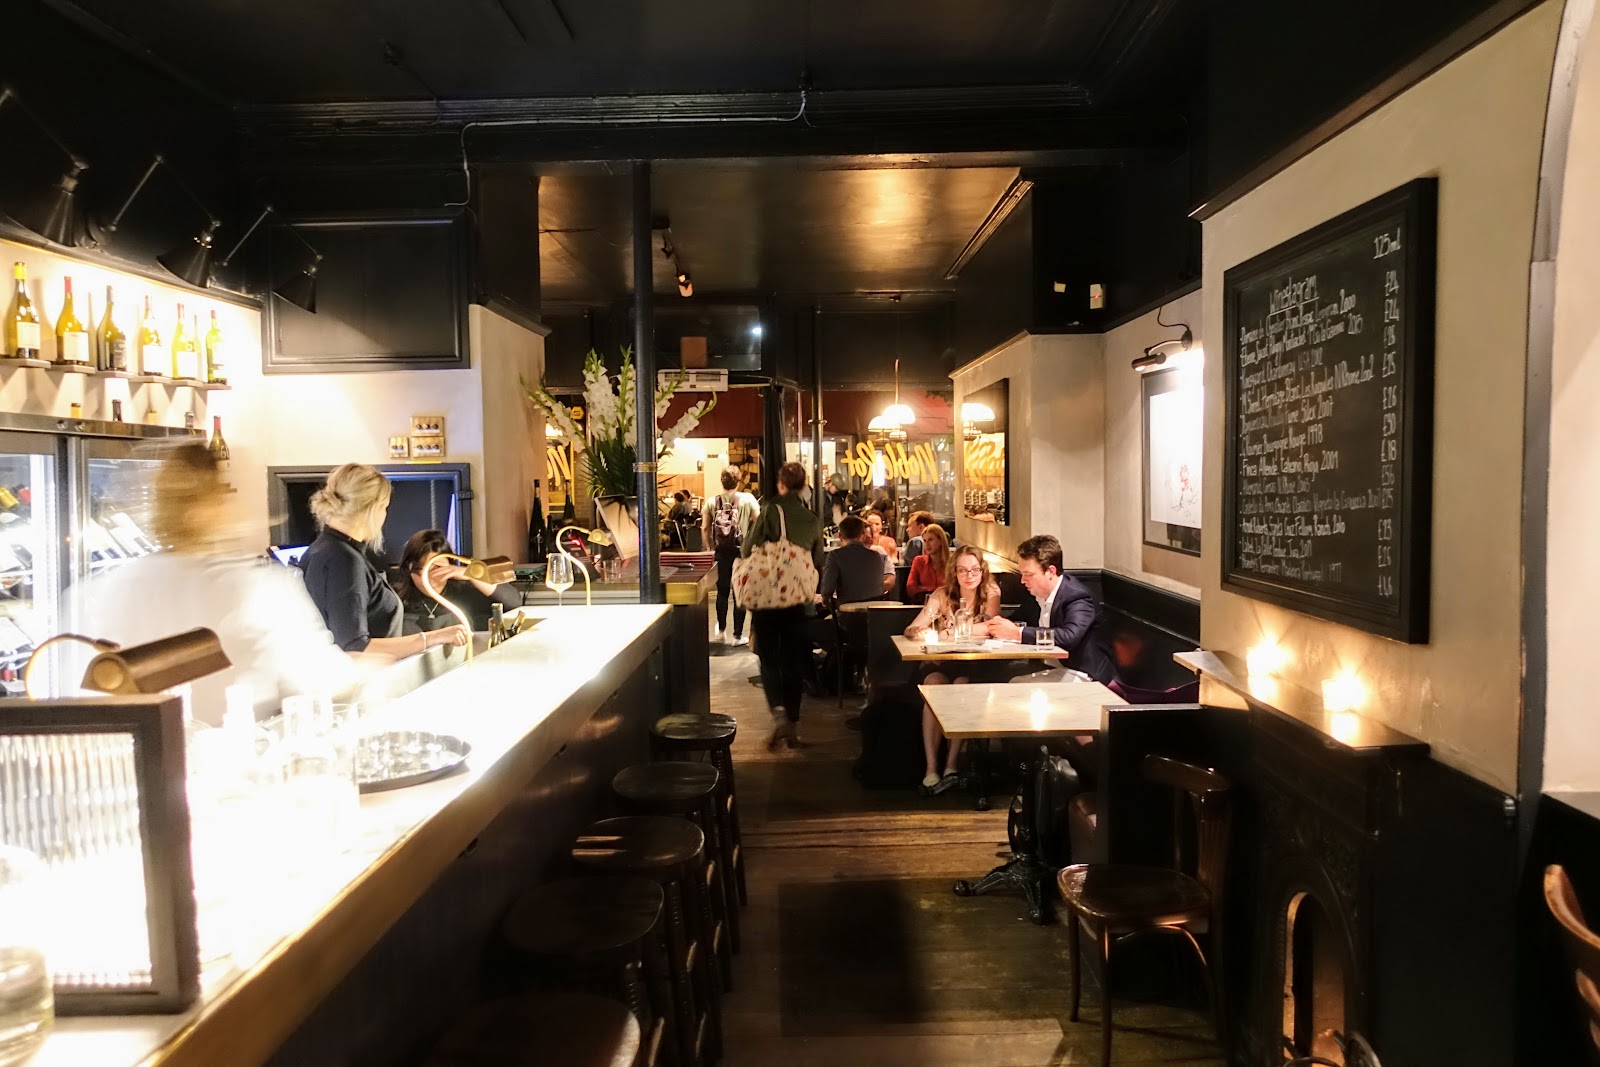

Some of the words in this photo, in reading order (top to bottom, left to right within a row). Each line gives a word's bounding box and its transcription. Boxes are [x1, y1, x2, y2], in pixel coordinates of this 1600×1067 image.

[1307, 423, 1322, 444] 1998
[1320, 450, 1338, 470] 2001
[1380, 439, 1396, 461] £18
